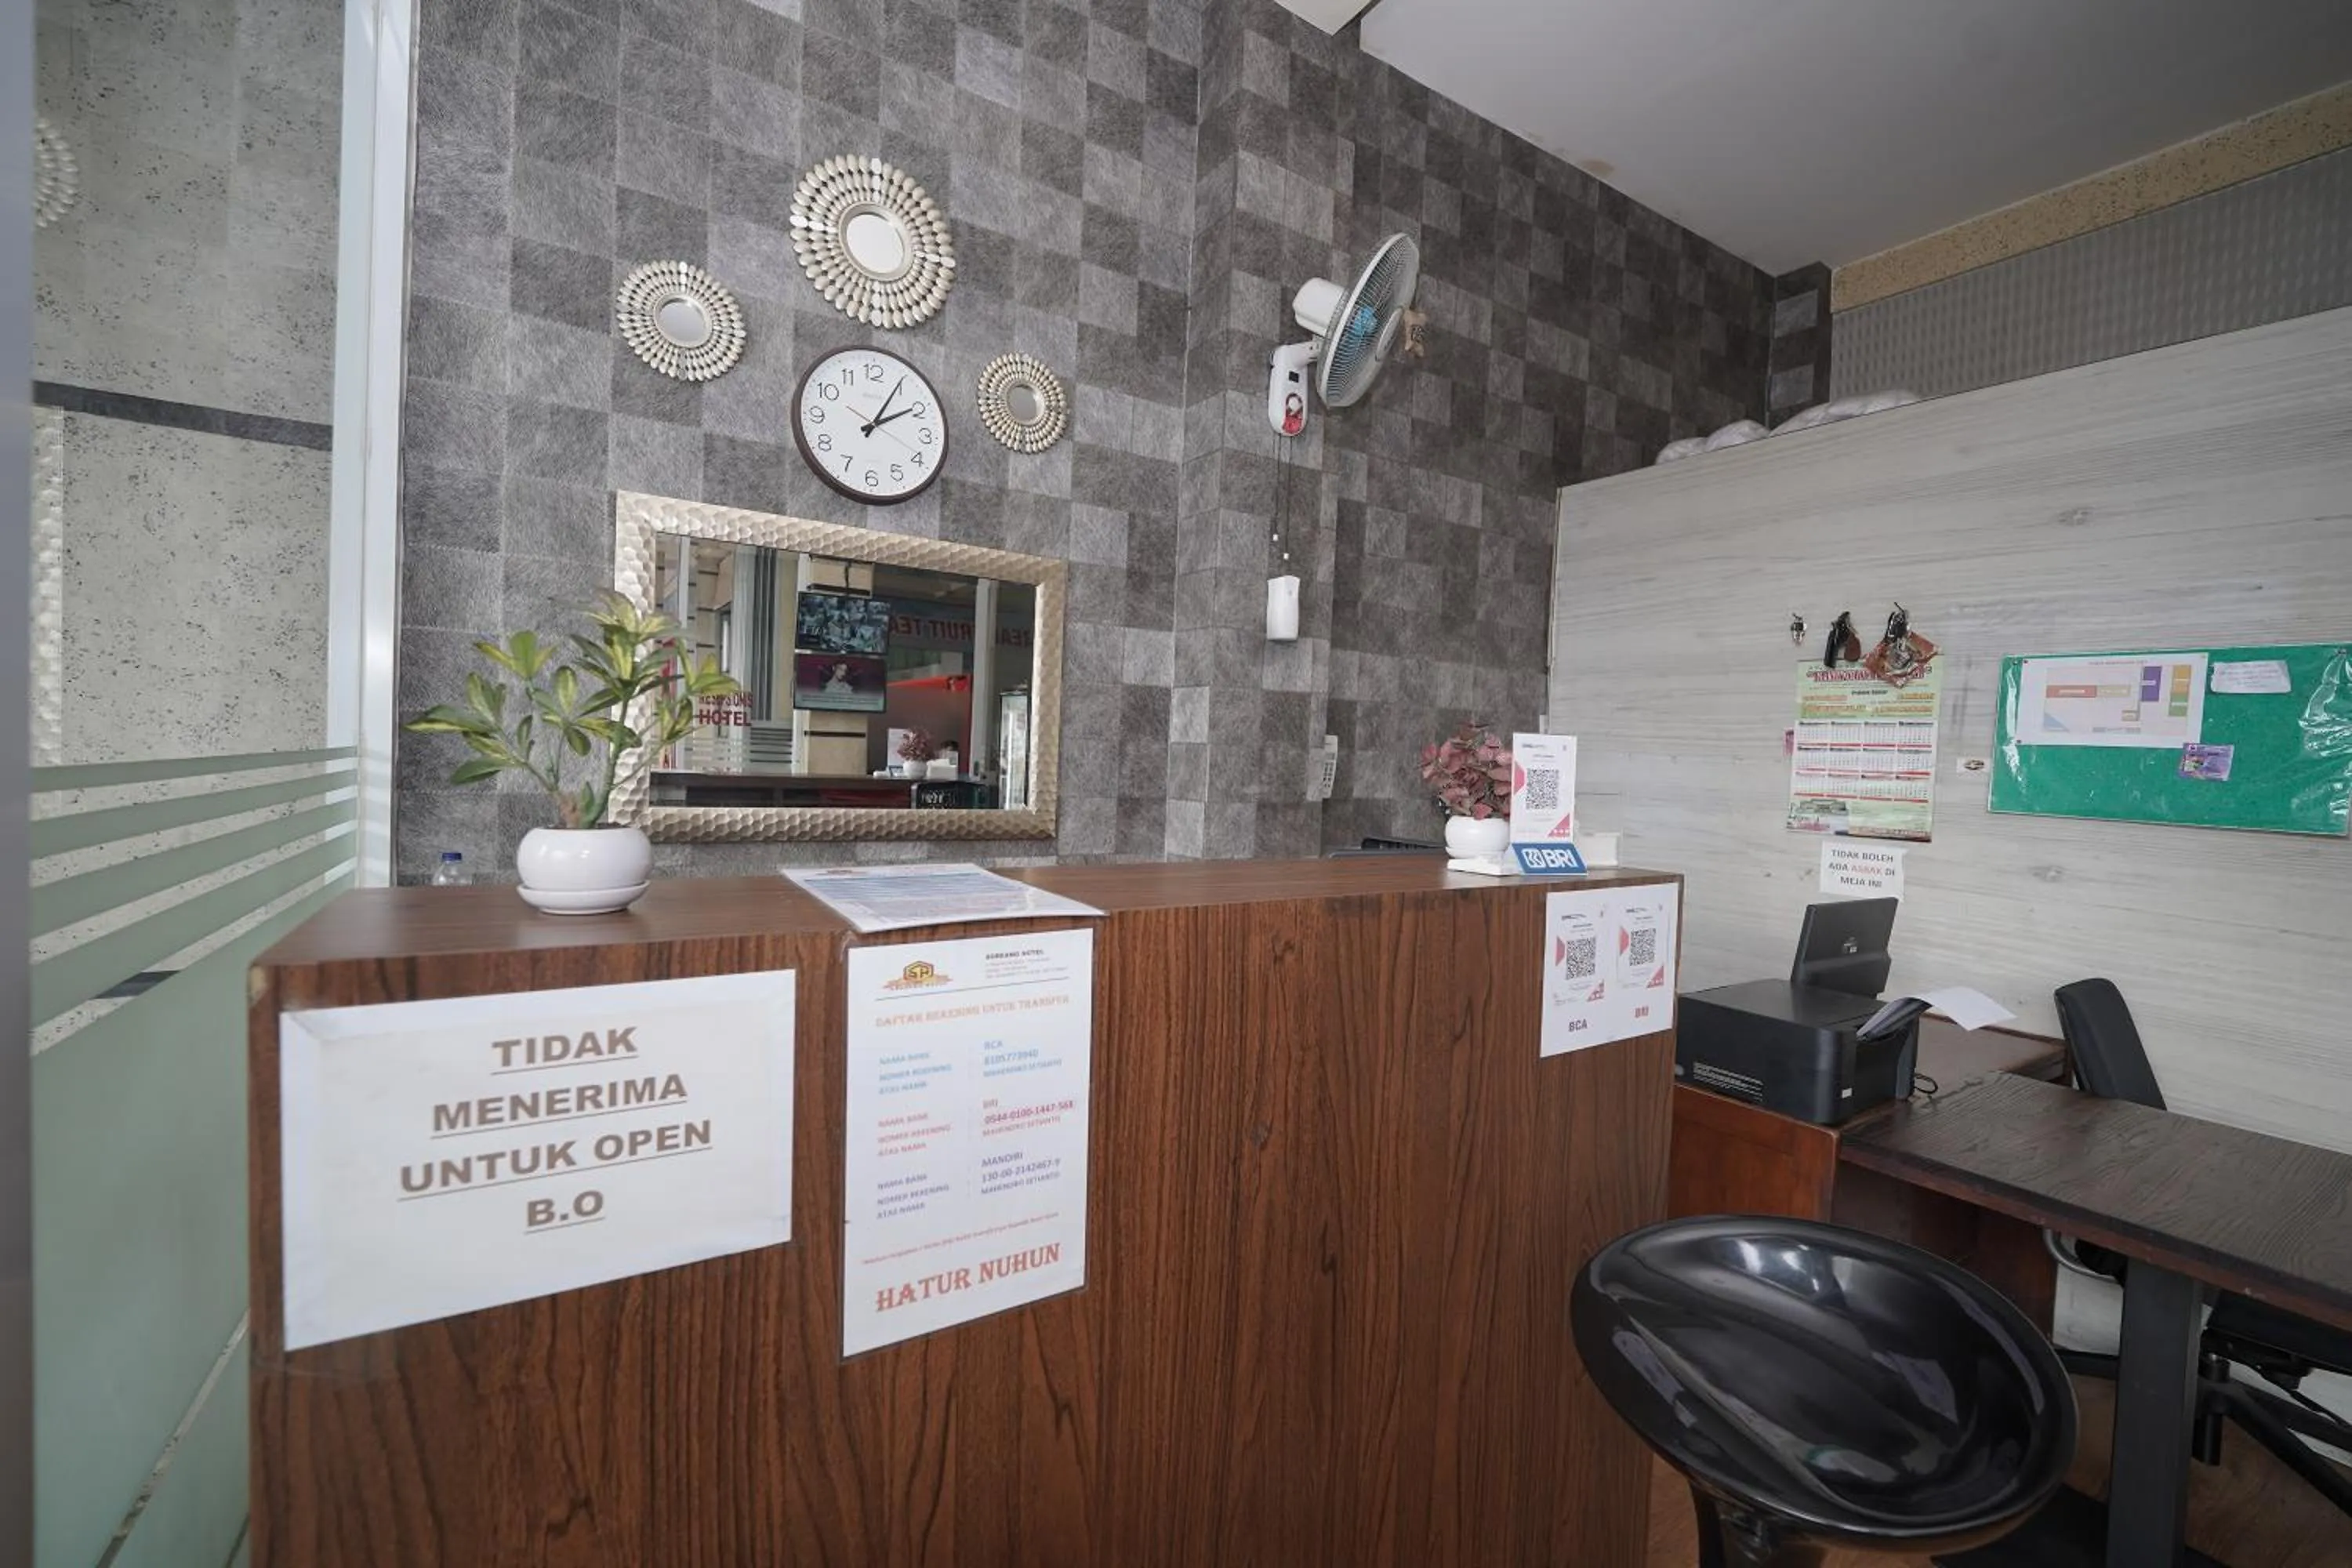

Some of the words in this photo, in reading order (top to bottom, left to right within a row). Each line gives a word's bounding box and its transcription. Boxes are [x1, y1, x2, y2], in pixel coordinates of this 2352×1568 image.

[841, 368, 854, 386] 11
[863, 364, 884, 383] 12
[817, 382, 840, 401] 10
[810, 405, 825, 424] 9
[913, 401, 926, 419] 2
[818, 434, 832, 452] 8
[919, 427, 932, 445] 3
[840, 454, 853, 472] 7
[911, 452, 924, 468] 4
[865, 470, 879, 487] 6
[890, 463, 904, 481] 5
[699, 709, 752, 726] HOTEL
[1543, 849, 1578, 868] BRI
[1831, 849, 1860, 859] TIDAK
[1862, 852, 1893, 862] BOLEH
[1569, 1018, 1588, 1032] BCA
[492, 1027, 638, 1067] TIDAK
[434, 1074, 688, 1131] MENERIMA
[401, 1141, 577, 1192] UNTUK
[594, 1120, 711, 1161] OPEN
[982, 1152, 1023, 1167] MANDIRI
[527, 1190, 604, 1228] B.O
[877, 1268, 971, 1312] HATUR
[978, 1243, 1060, 1284] NUHUN
